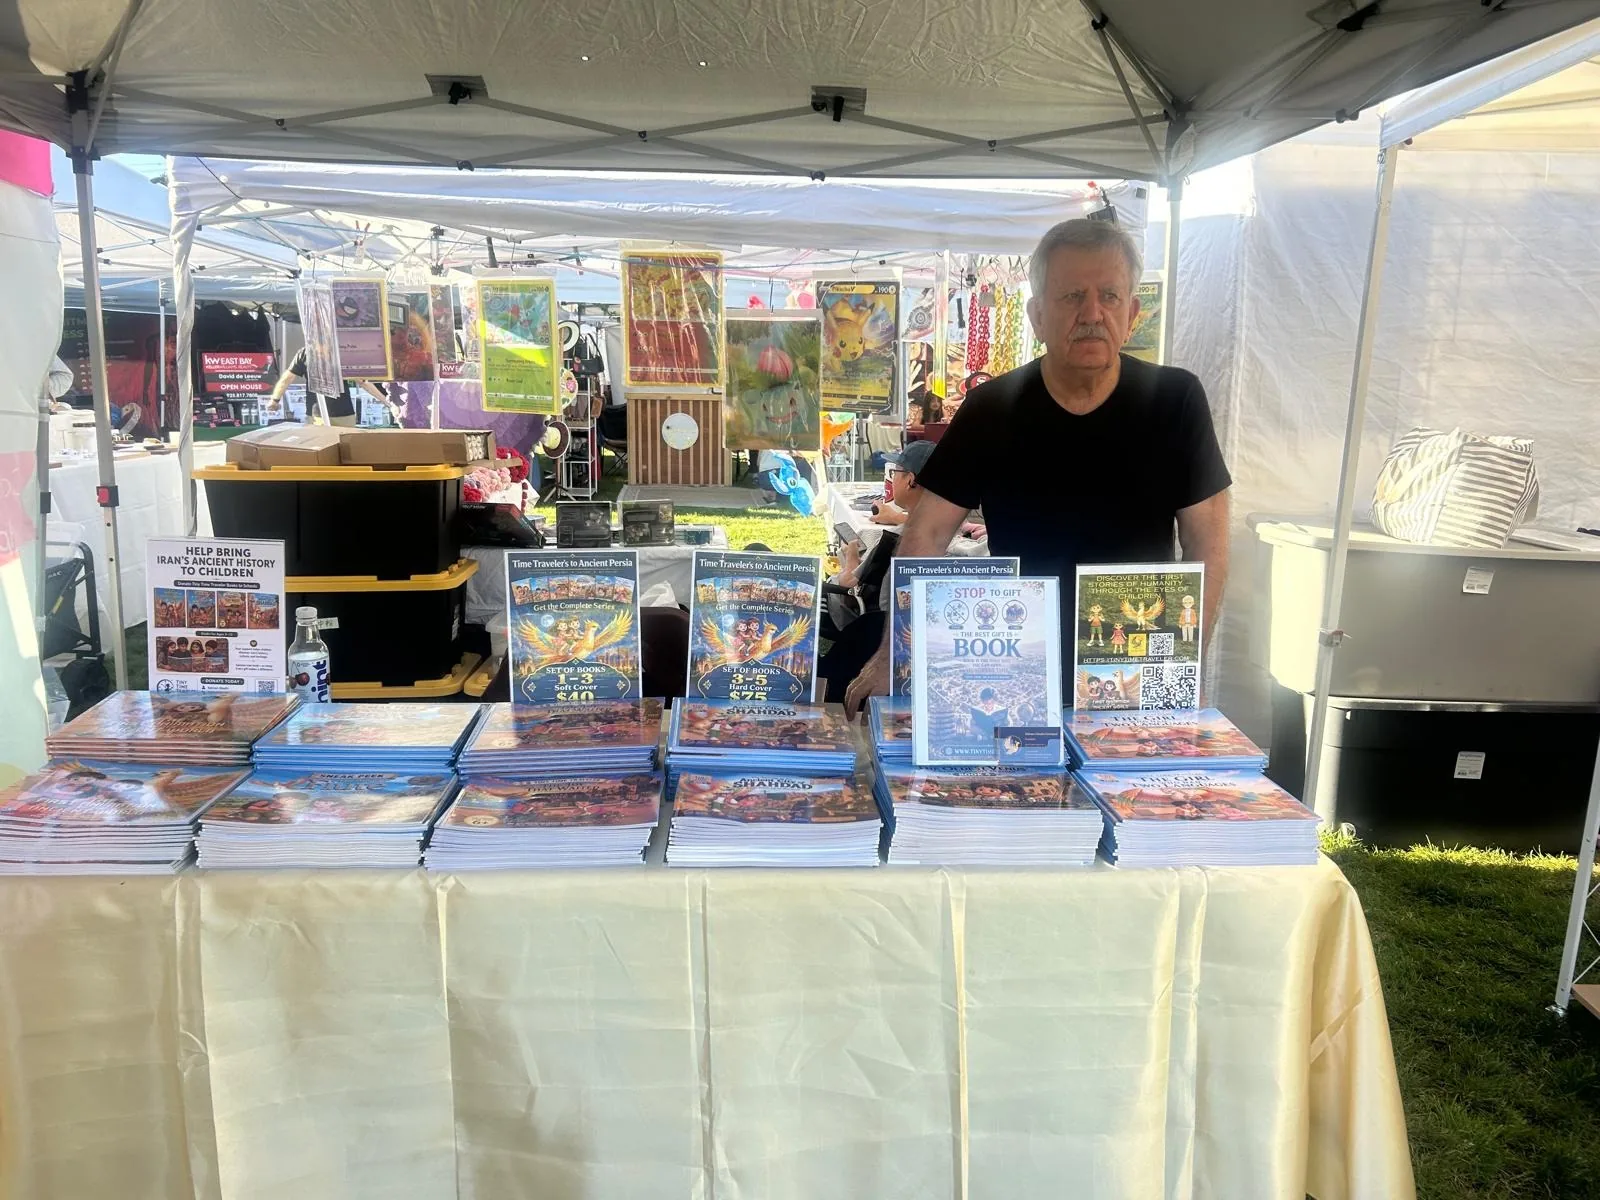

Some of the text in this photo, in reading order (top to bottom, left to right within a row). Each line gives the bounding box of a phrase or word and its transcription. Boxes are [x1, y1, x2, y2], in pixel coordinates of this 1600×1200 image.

[205, 356, 220, 364] kw
[186, 547, 251, 557] HELP BRING
[157, 556, 276, 569] IRAN'S ANCIENT HISTORY
[512, 560, 532, 568] Time
[533, 559, 569, 568] Traveler's
[579, 559, 608, 567] Ancient
[609, 559, 632, 567] Persia
[699, 559, 815, 573] Time Traveler's to Ancient Persia
[181, 566, 254, 578] TO CHILDREN
[898, 566, 916, 574] Time
[918, 566, 952, 574] Traveler's
[961, 565, 990, 574] Ancient
[991, 565, 1014, 574] Persia
[954, 588, 985, 598] STOP
[560, 602, 592, 610] Complete
[742, 603, 772, 612] Complete
[773, 606, 794, 614] Series
[953, 638, 1022, 657] BOOK
[557, 691, 594, 701] $40
[729, 690, 767, 701] $75
[726, 708, 796, 717] SHAHDAD
[732, 781, 813, 790] SHAHDAD
